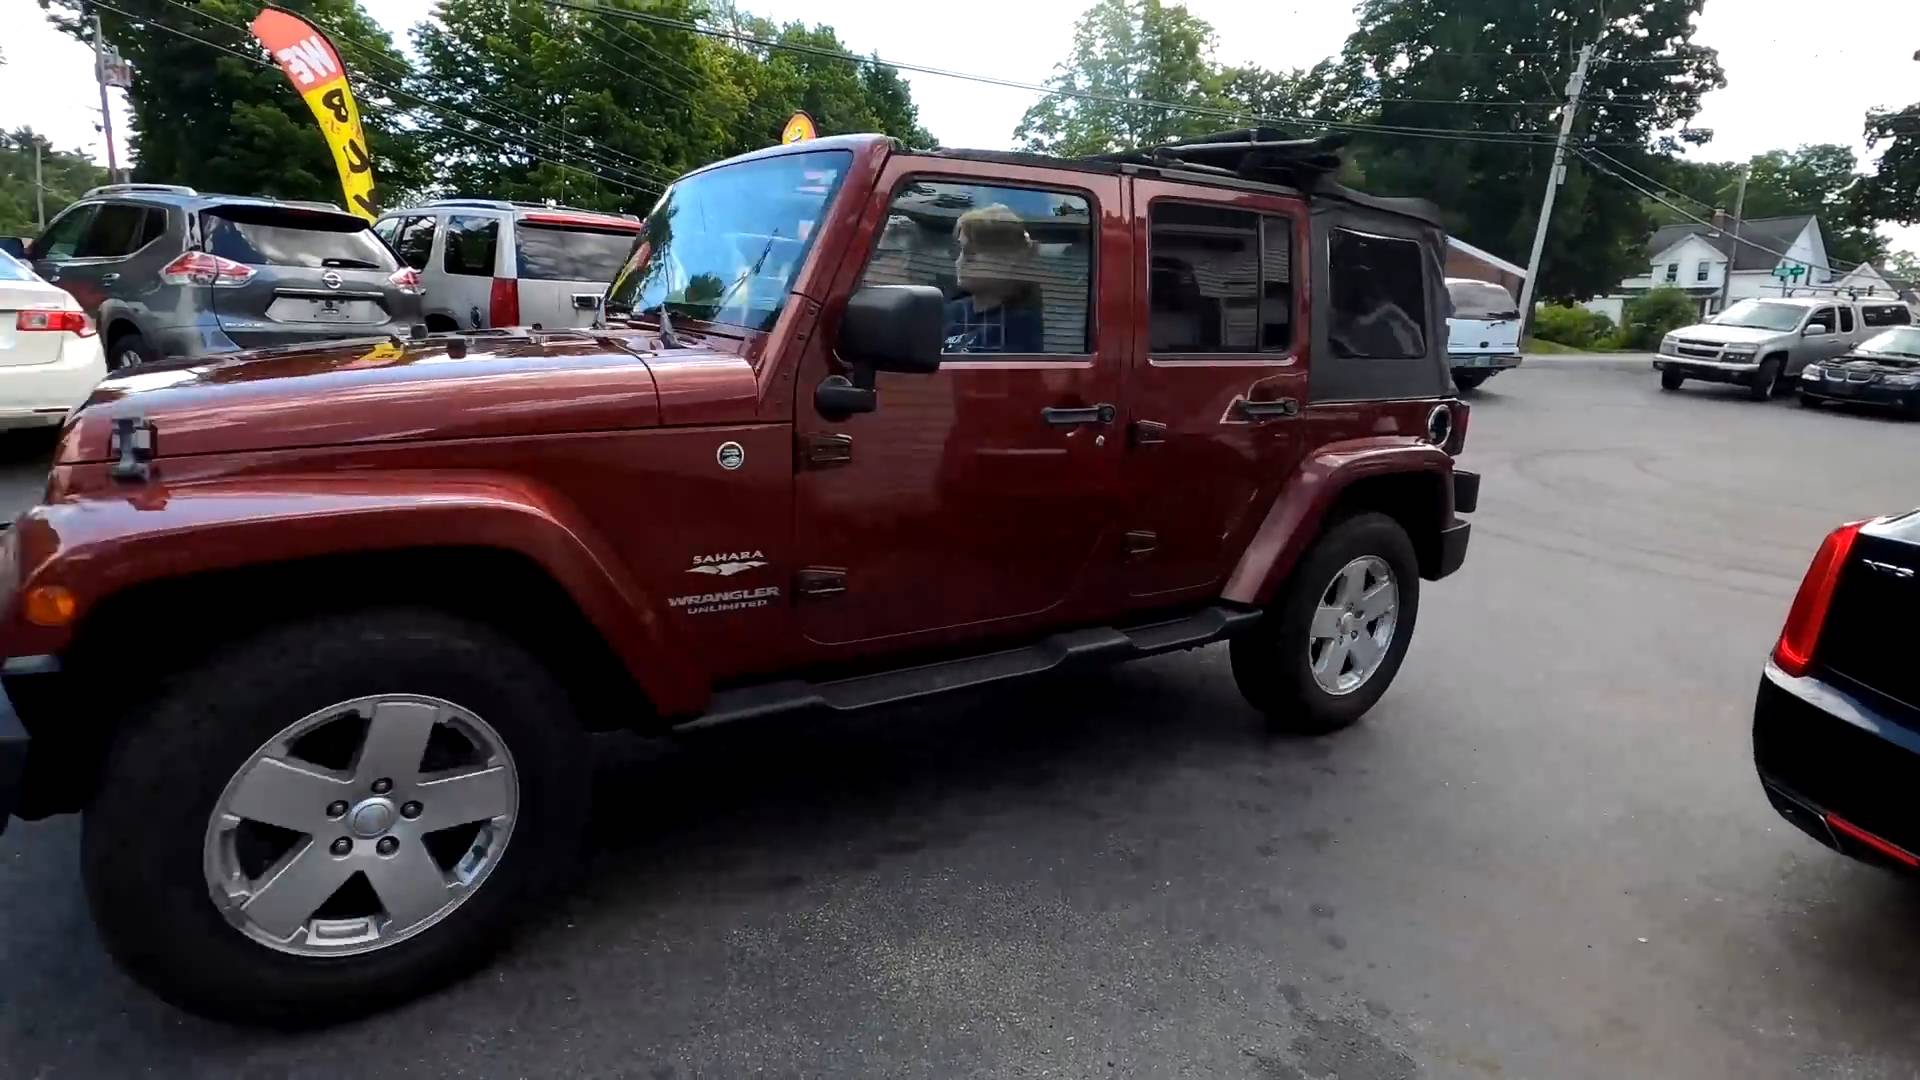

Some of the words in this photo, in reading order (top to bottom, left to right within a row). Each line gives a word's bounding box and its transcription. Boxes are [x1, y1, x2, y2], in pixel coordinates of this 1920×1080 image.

[693, 550, 764, 564] SAHARA
[667, 586, 780, 607] WRANGLER
[687, 599, 768, 614] UNLIMITED
